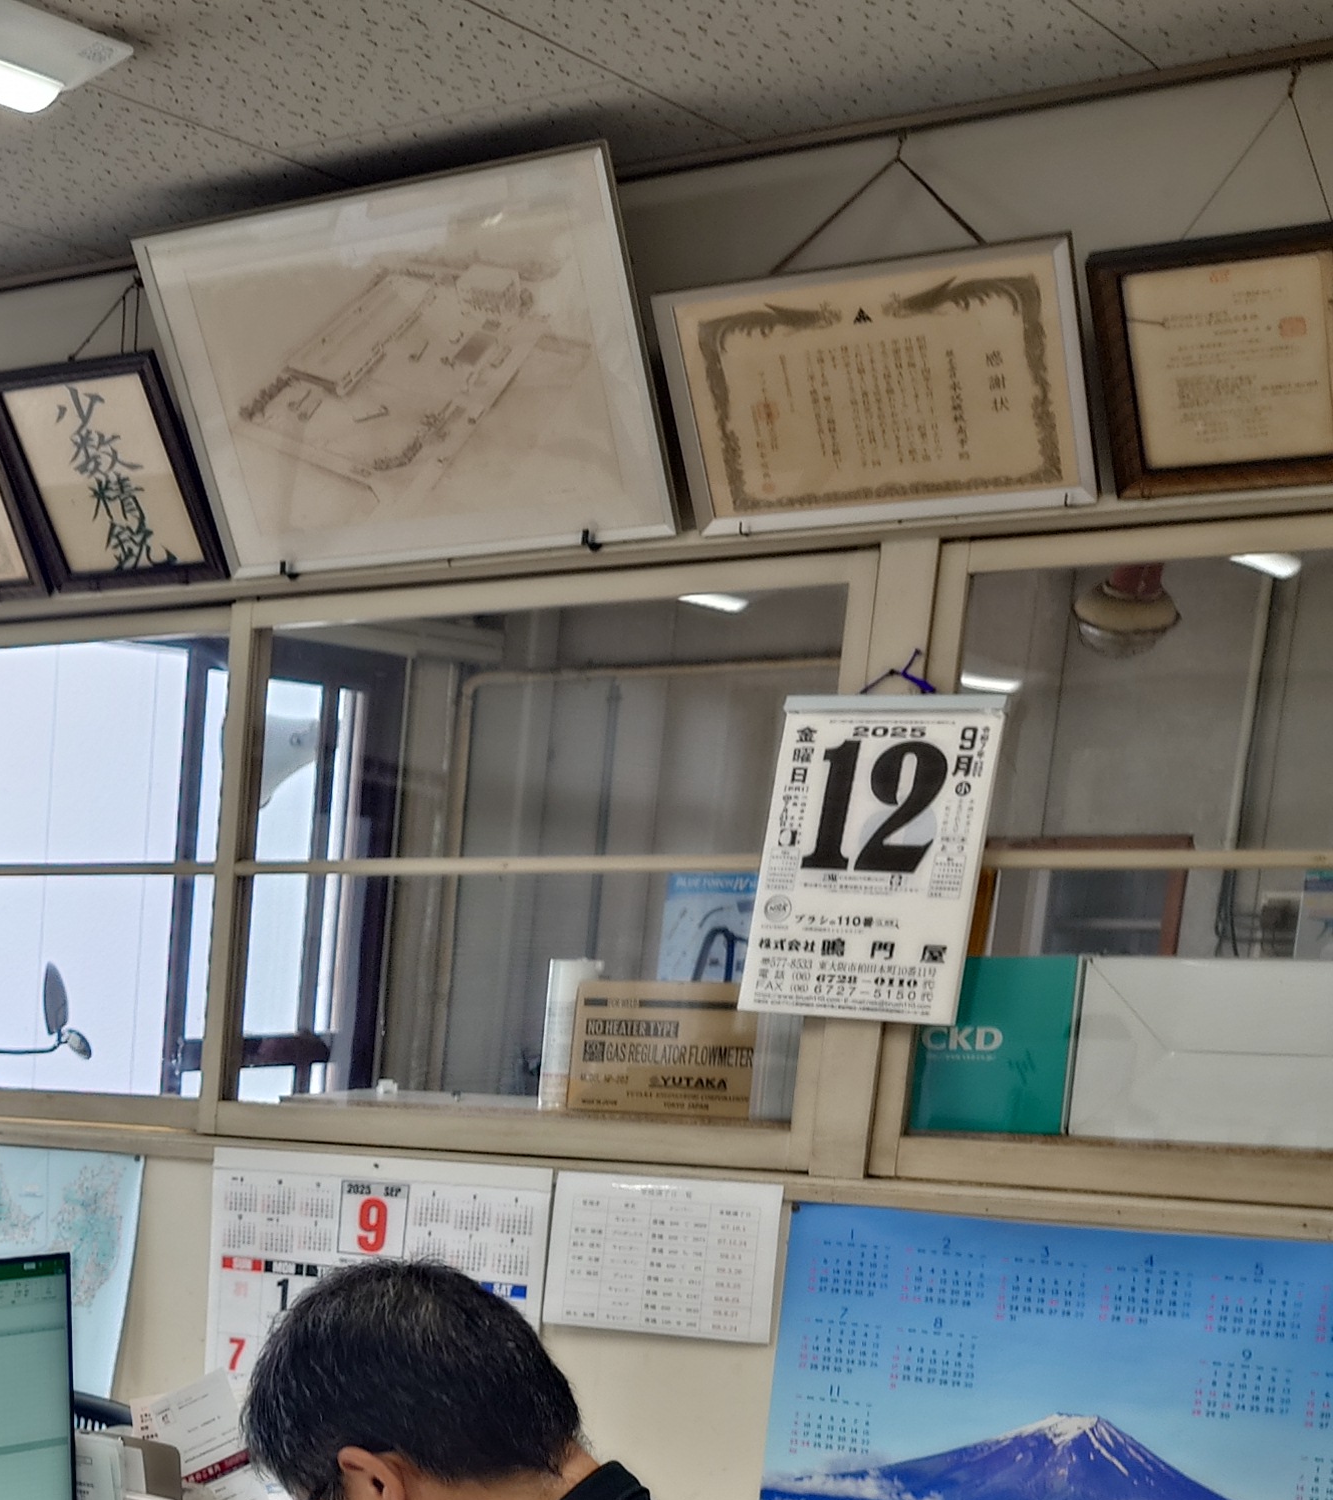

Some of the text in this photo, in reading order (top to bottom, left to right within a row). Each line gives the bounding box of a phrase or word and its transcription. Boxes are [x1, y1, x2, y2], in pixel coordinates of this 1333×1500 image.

[852, 726, 927, 739] 2025
[790, 726, 818, 784] 金曜日
[800, 739, 949, 874] 12
[758, 936, 816, 954] 株式会社
[587, 1019, 678, 1037] NO HEATER TYPE
[921, 1025, 1004, 1051] CKD
[606, 1042, 627, 1062] GAS
[627, 1043, 687, 1065] REGULATOR
[661, 1075, 728, 1090] YUTAKA
[356, 1197, 388, 1255] 9
[228, 1337, 246, 1371] 7
